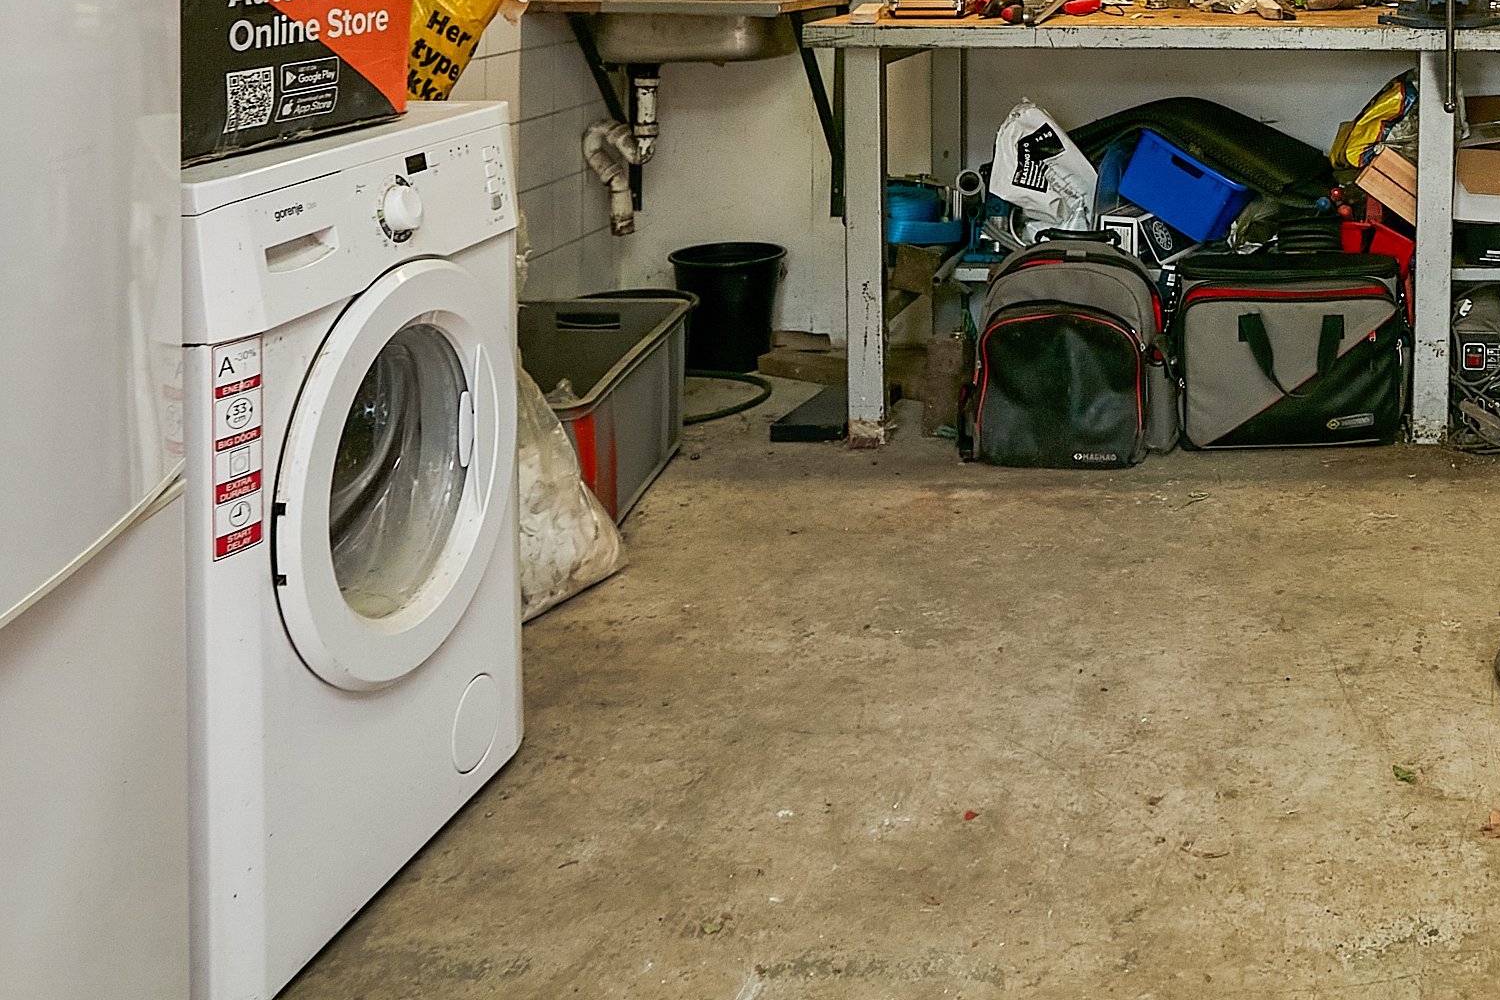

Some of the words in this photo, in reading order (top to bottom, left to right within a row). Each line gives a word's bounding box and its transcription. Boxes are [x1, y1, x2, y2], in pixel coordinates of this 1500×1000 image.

[229, 18, 320, 52] Online
[327, 7, 389, 39] Store
[426, 9, 473, 48] Her
[411, 37, 460, 82] type
[298, 71, 322, 83] Google
[322, 69, 336, 80] Play
[293, 102, 311, 115] App
[310, 100, 332, 111] Store
[1020, 153, 1031, 184] BLASTING
[274, 202, 304, 222] gorenje
[218, 356, 235, 378] A
[232, 402, 248, 416] 33
[233, 414, 247, 424] cm
[218, 438, 234, 450] BIG
[226, 477, 252, 492] EXTRA
[219, 483, 257, 503] DURABLE
[227, 528, 252, 544] START
[226, 538, 252, 552] DELAY
